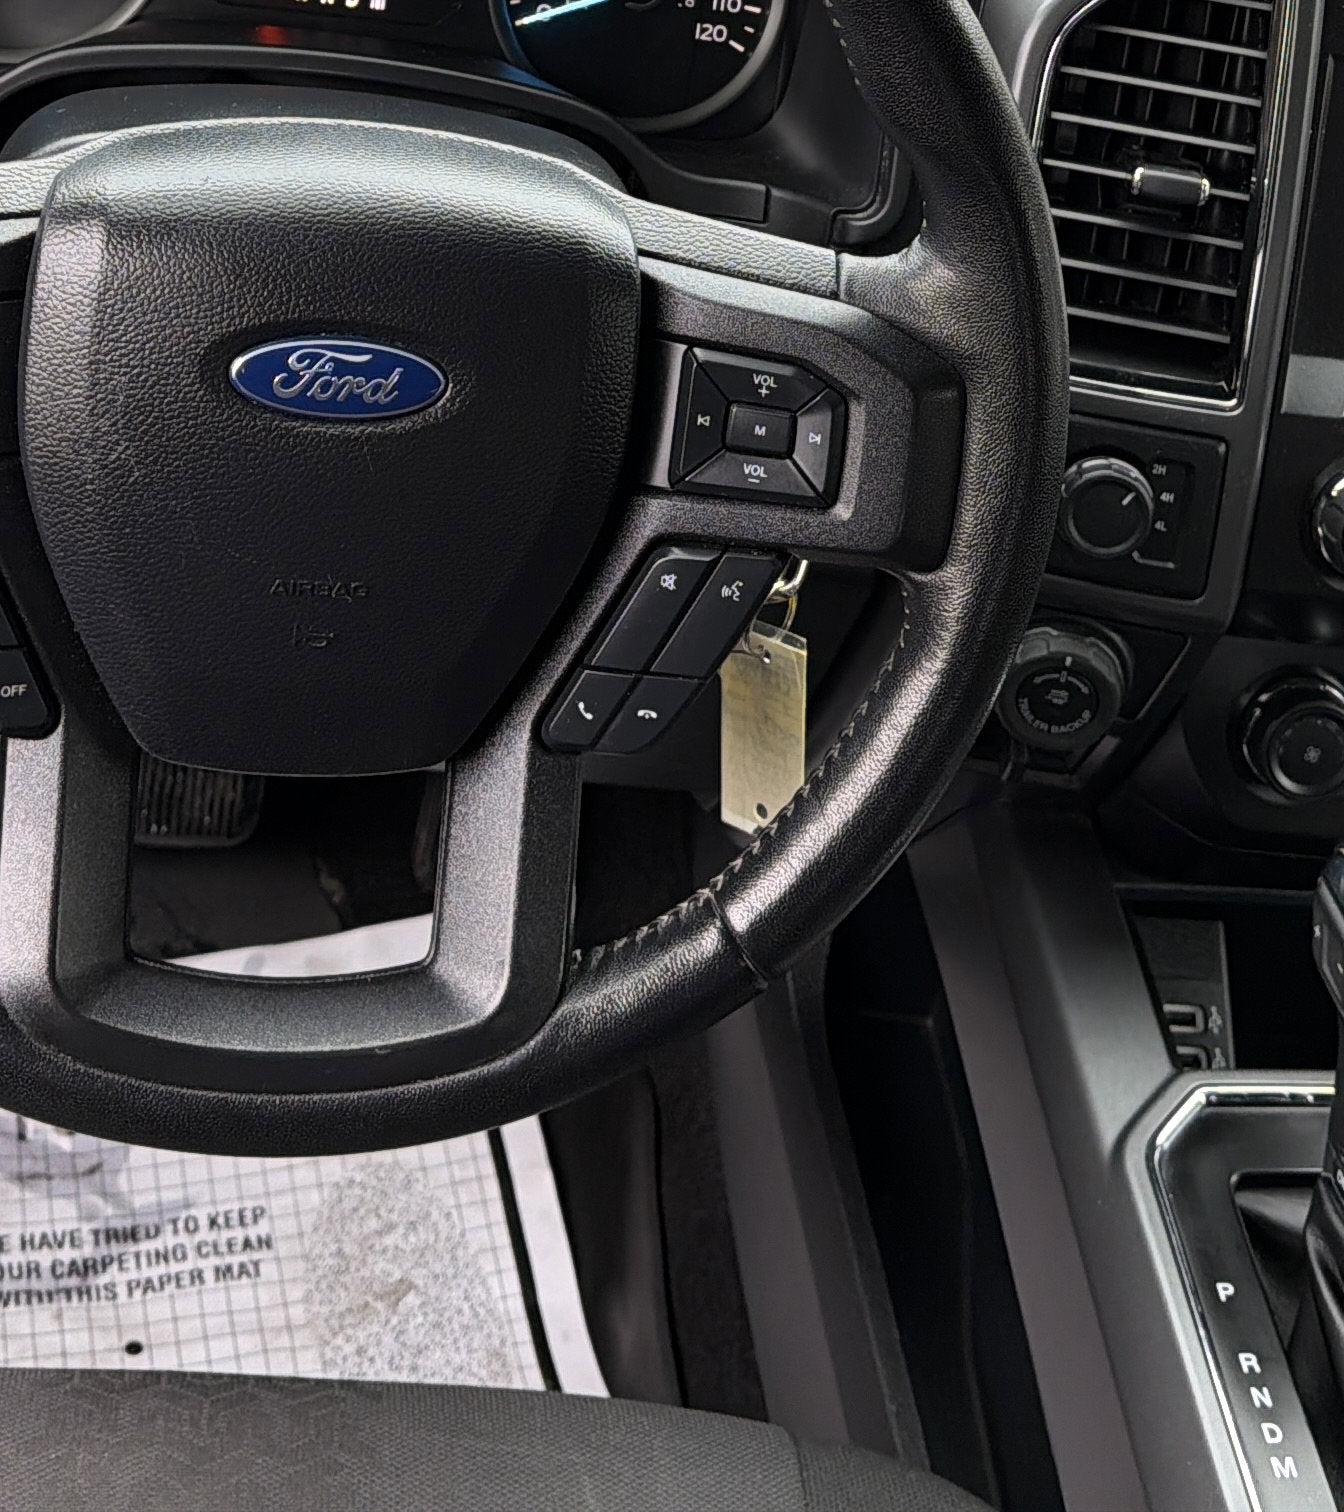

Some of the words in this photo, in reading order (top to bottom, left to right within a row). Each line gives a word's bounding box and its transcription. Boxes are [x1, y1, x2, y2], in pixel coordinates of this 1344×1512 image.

[694, 22, 728, 42] 120
[272, 347, 405, 406] Ford
[752, 373, 778, 389] VOL
[754, 424, 767, 437] M
[742, 462, 768, 479] VOL
[1152, 463, 1167, 476] 2H
[1159, 491, 1175, 505] 4H
[1154, 519, 1168, 532] 4L
[0, 682, 29, 700] OFF
[19, 1226, 83, 1253] HAVE
[90, 1221, 161, 1248] TRIED
[169, 1214, 201, 1238] TO
[206, 1204, 267, 1233] KEEP
[50, 1241, 189, 1281] CARPETING
[196, 1232, 275, 1260] CLEAN
[57, 1280, 118, 1304] THIS
[126, 1267, 206, 1299] PAPER
[212, 1258, 264, 1284] MAT
[1215, 1281, 1235, 1304] P
[1237, 1351, 1263, 1376] R
[1249, 1386, 1273, 1409] N
[1261, 1422, 1284, 1445] D
[1269, 1456, 1299, 1480] M
